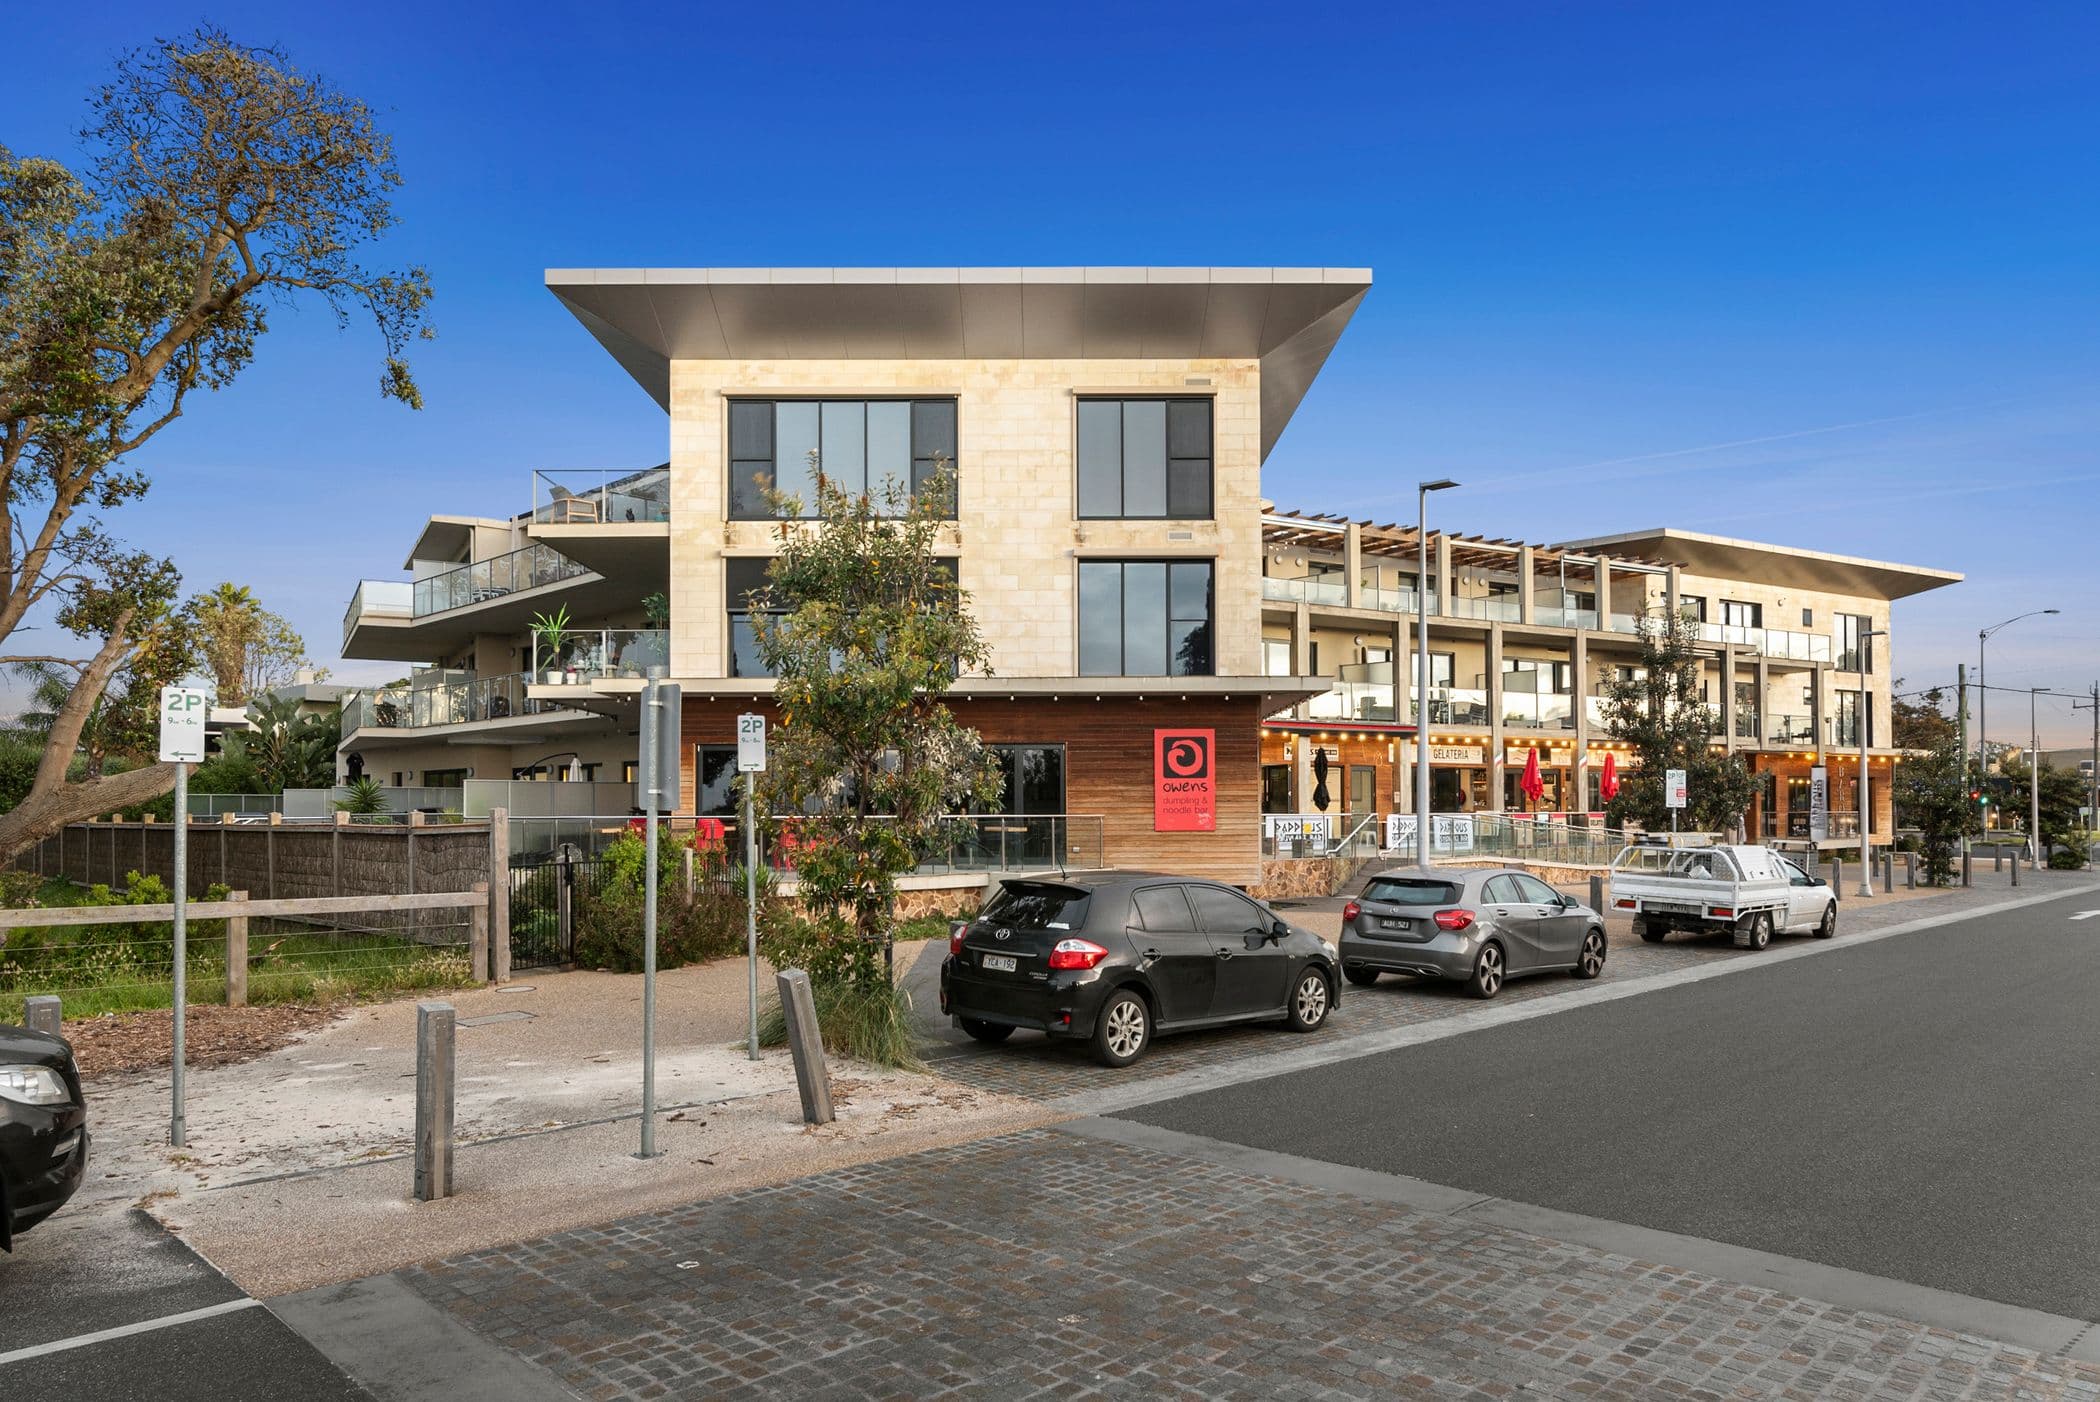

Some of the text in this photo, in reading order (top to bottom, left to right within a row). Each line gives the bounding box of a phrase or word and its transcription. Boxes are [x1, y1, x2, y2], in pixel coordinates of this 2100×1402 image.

[167, 693, 202, 711] 2P
[742, 719, 763, 733] 2P
[1433, 748, 1469, 760] GELATERIA
[1163, 781, 1208, 793] owens
[1163, 796, 1208, 806] dumpling &
[1163, 805, 1208, 814] noodle bar
